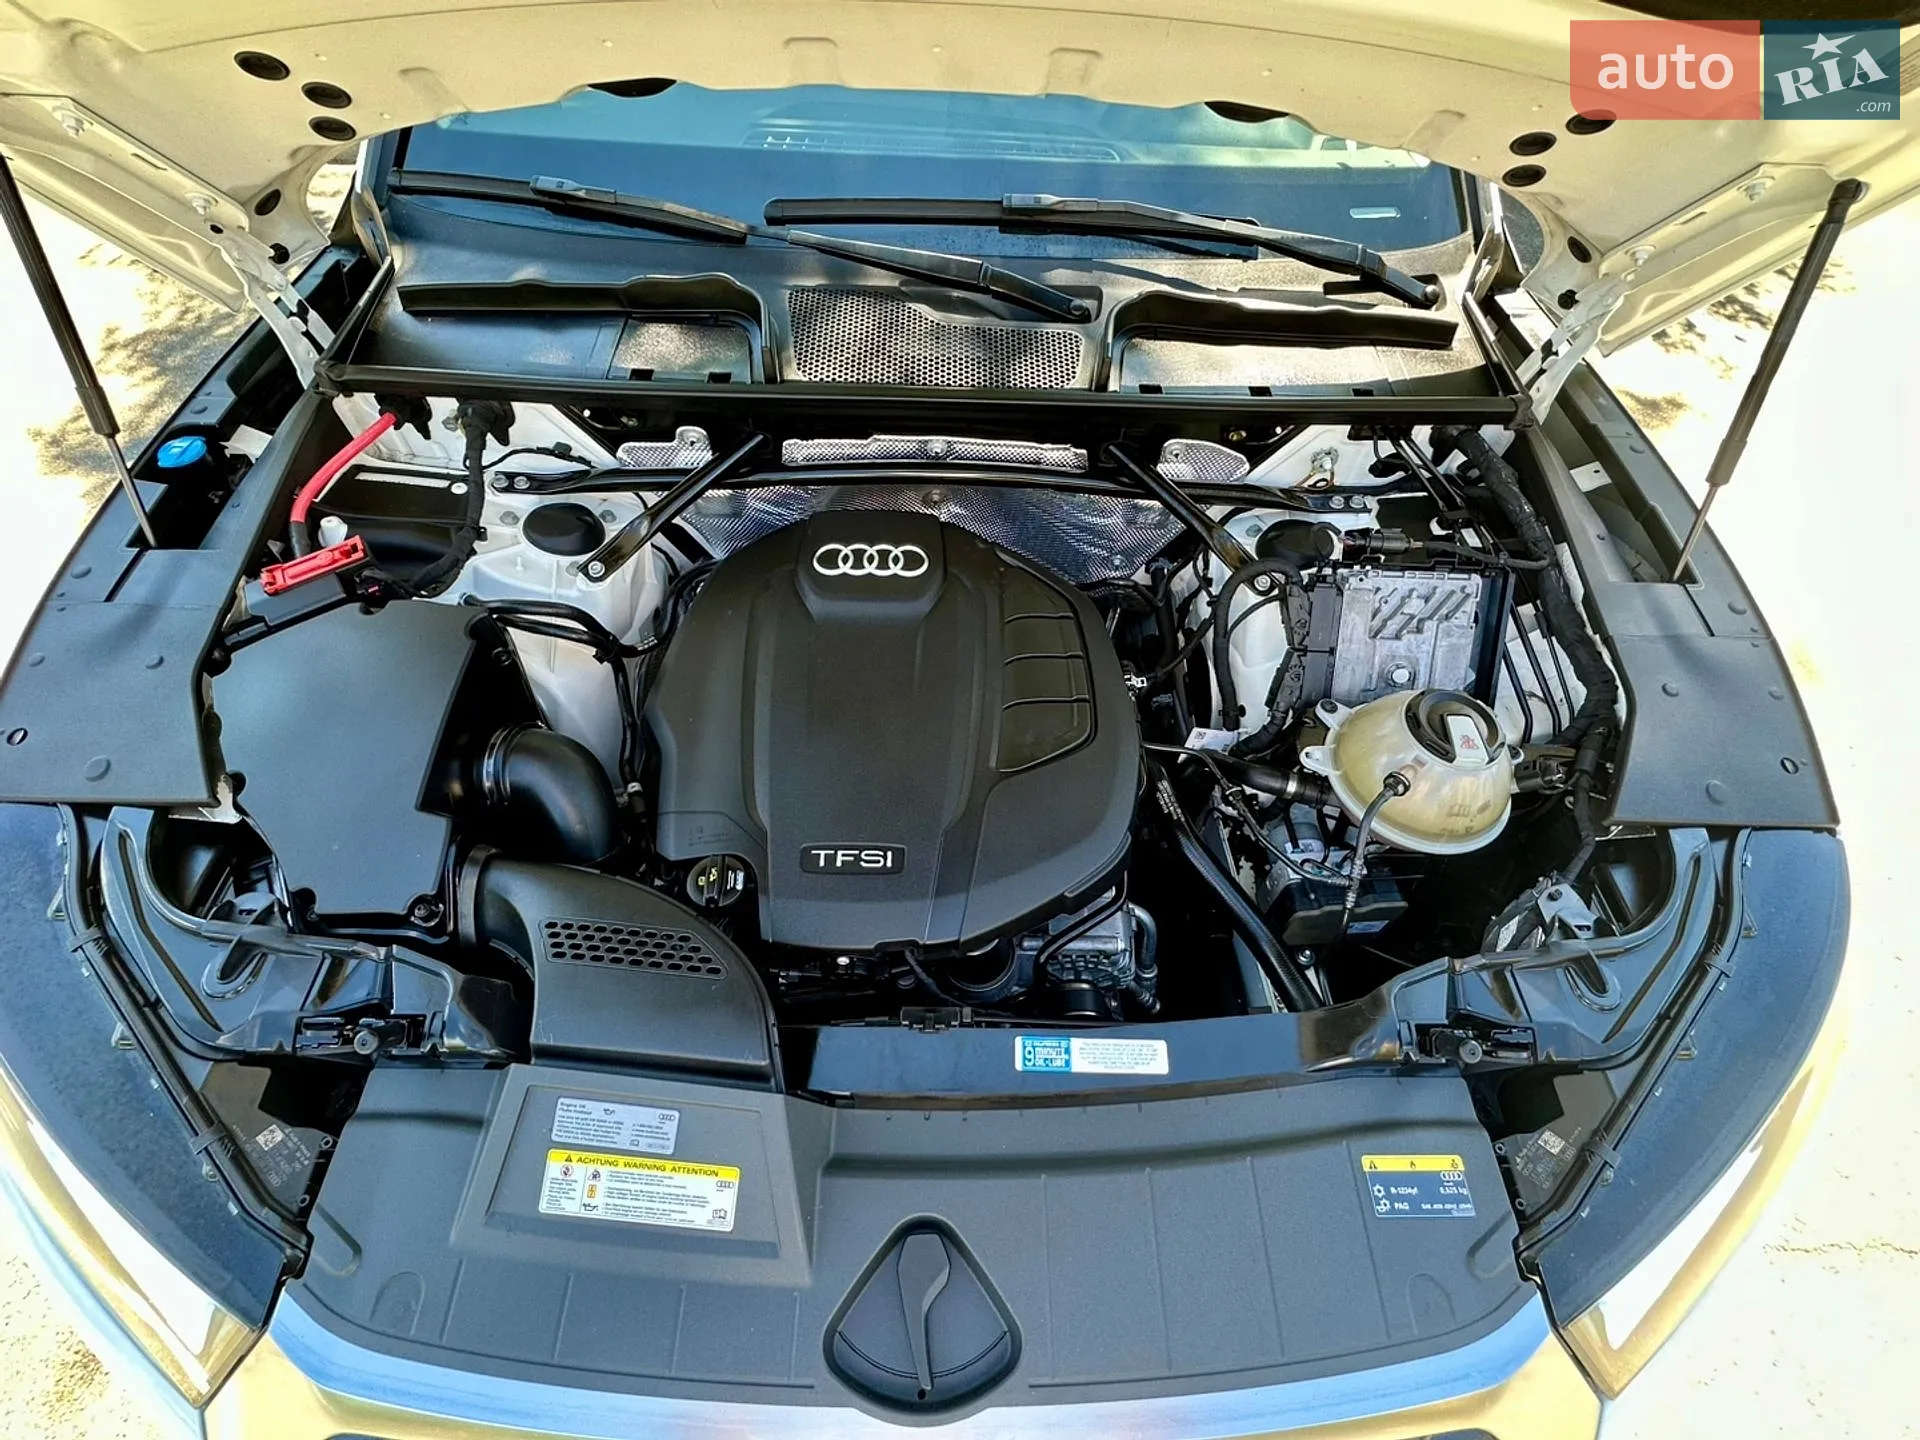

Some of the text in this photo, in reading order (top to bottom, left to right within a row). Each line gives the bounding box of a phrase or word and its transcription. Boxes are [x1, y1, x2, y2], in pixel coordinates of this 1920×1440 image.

[810, 850, 893, 868] TFSI
[1025, 1046, 1035, 1067] 9
[576, 1156, 619, 1167] ACHTUNG
[623, 1161, 667, 1172] WARNING
[670, 1165, 719, 1177] ATTENTION
